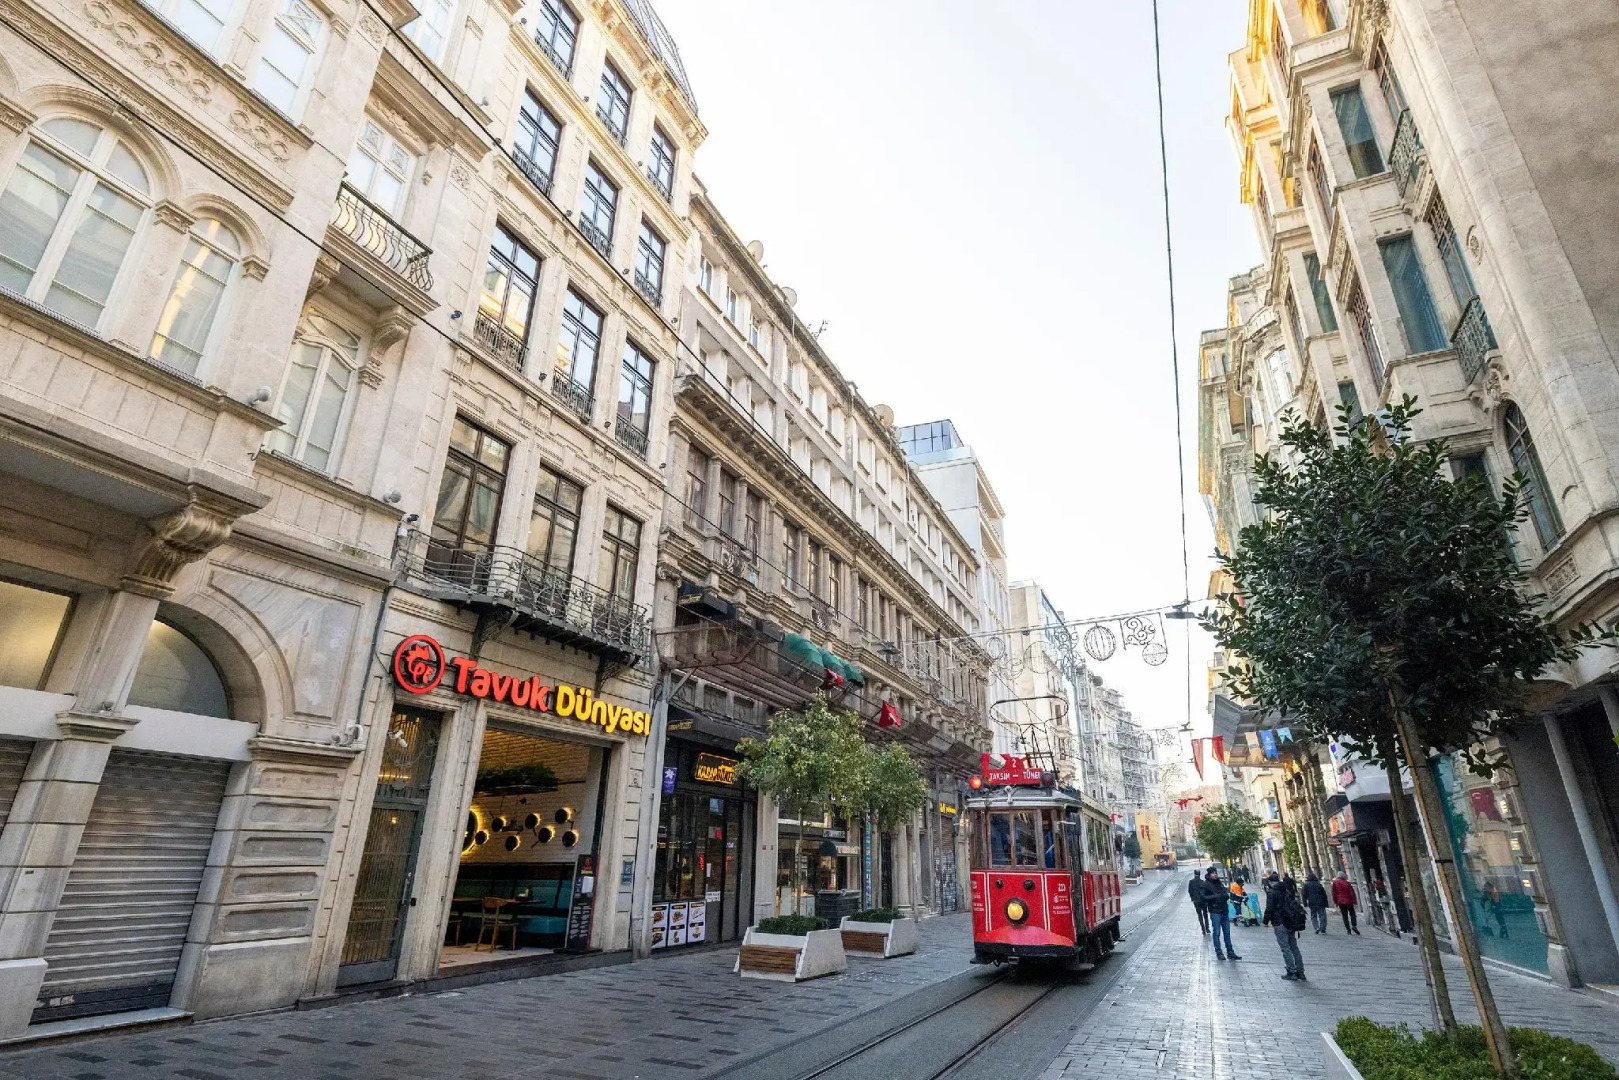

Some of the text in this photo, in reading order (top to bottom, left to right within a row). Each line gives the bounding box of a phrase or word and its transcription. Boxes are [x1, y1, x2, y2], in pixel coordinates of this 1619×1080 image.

[452, 656, 651, 736] Tavuk Dünyası
[1011, 758, 1017, 768] 2
